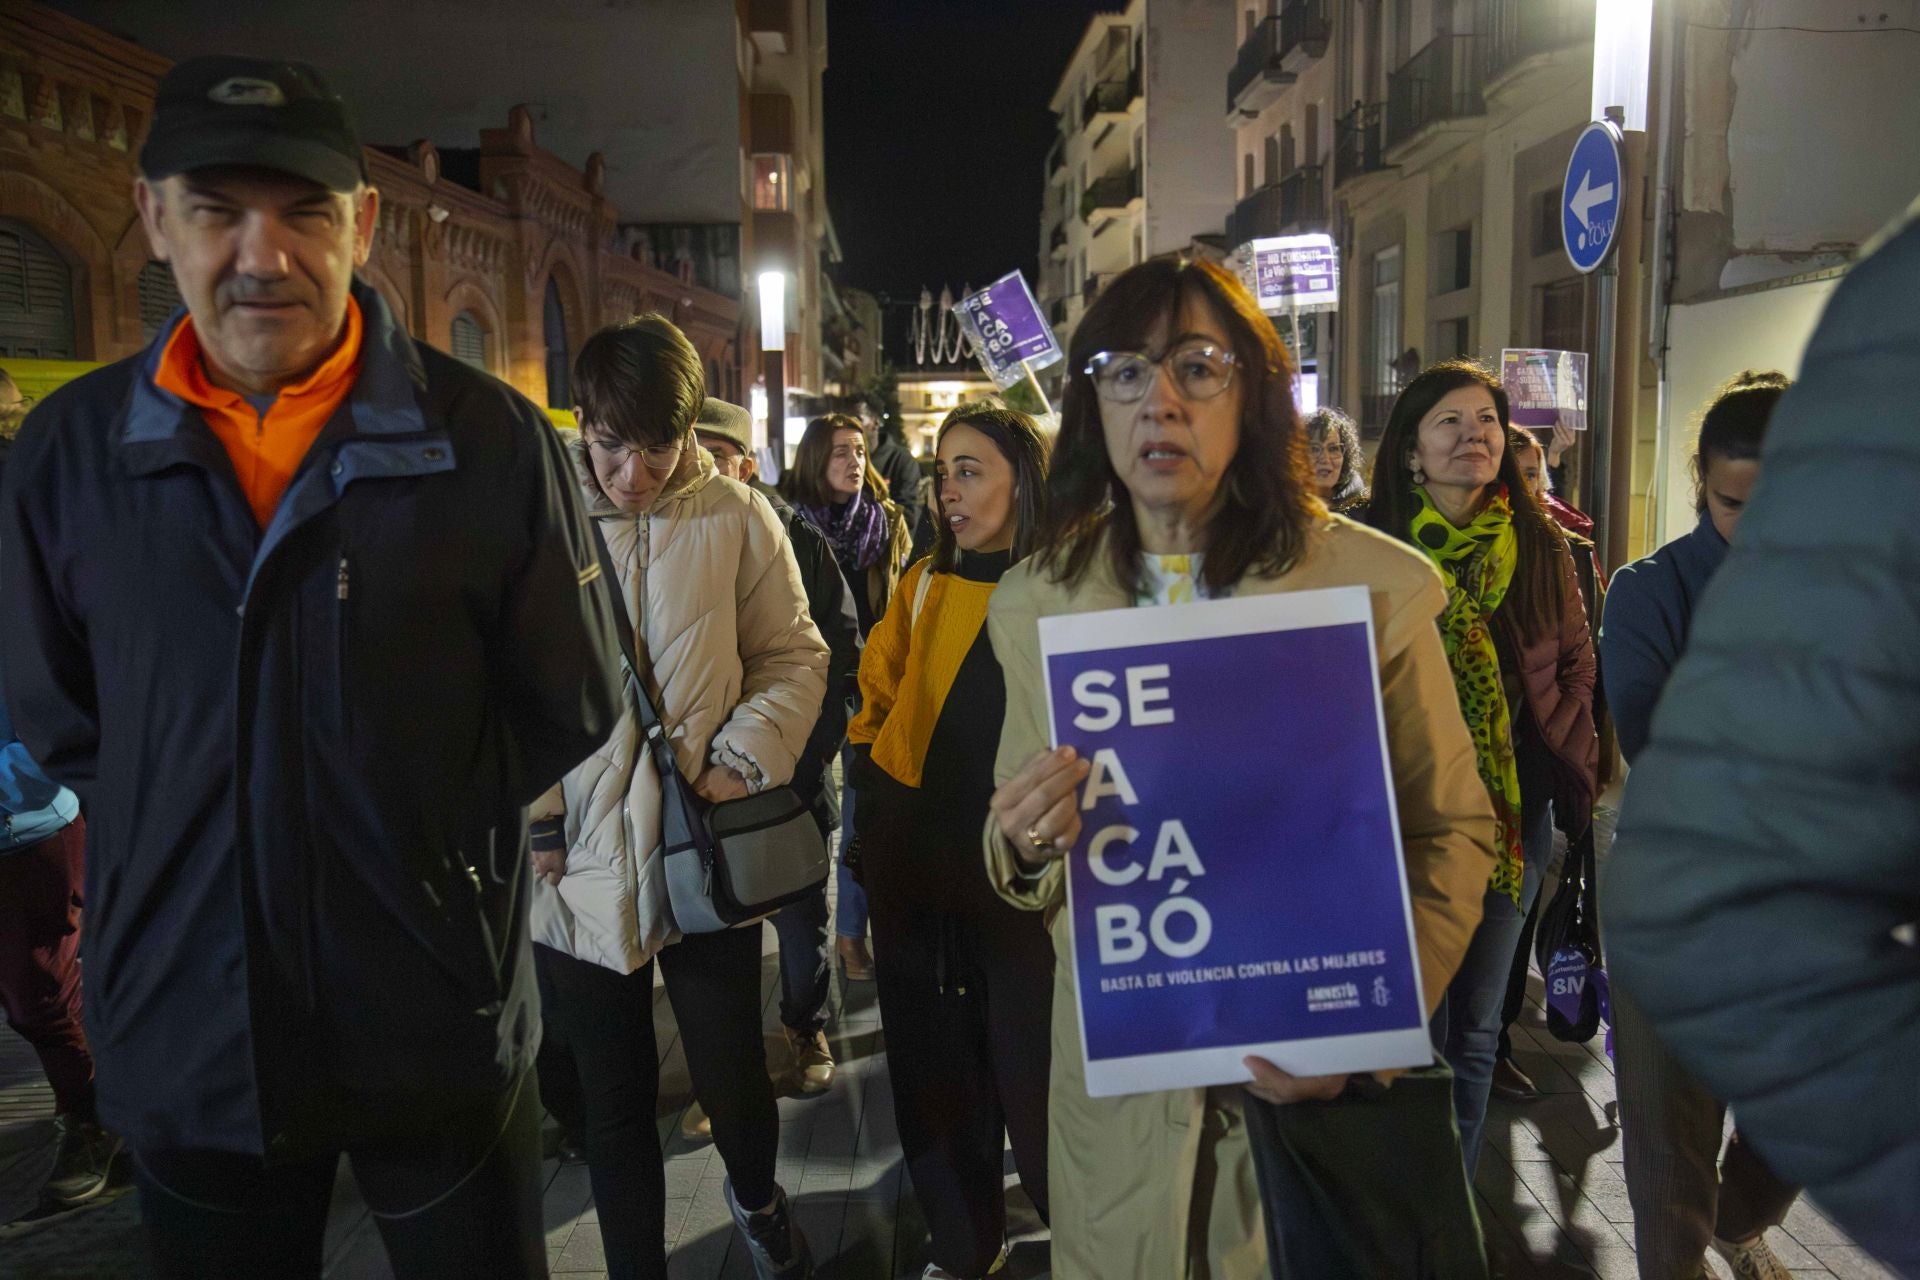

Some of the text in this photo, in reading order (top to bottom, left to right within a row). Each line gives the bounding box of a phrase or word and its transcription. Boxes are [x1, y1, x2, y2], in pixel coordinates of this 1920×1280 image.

[970, 292, 993, 311] SE
[978, 311, 990, 326] A
[983, 318, 1008, 338] CA
[1072, 664, 1175, 732] SE
[1081, 748, 1139, 810] A
[1088, 819, 1206, 886] CA
[1095, 878, 1212, 965] BÓ
[1101, 949, 1386, 993] BASTA DE VIOLENCIA CONTRA LAS MUJERES
